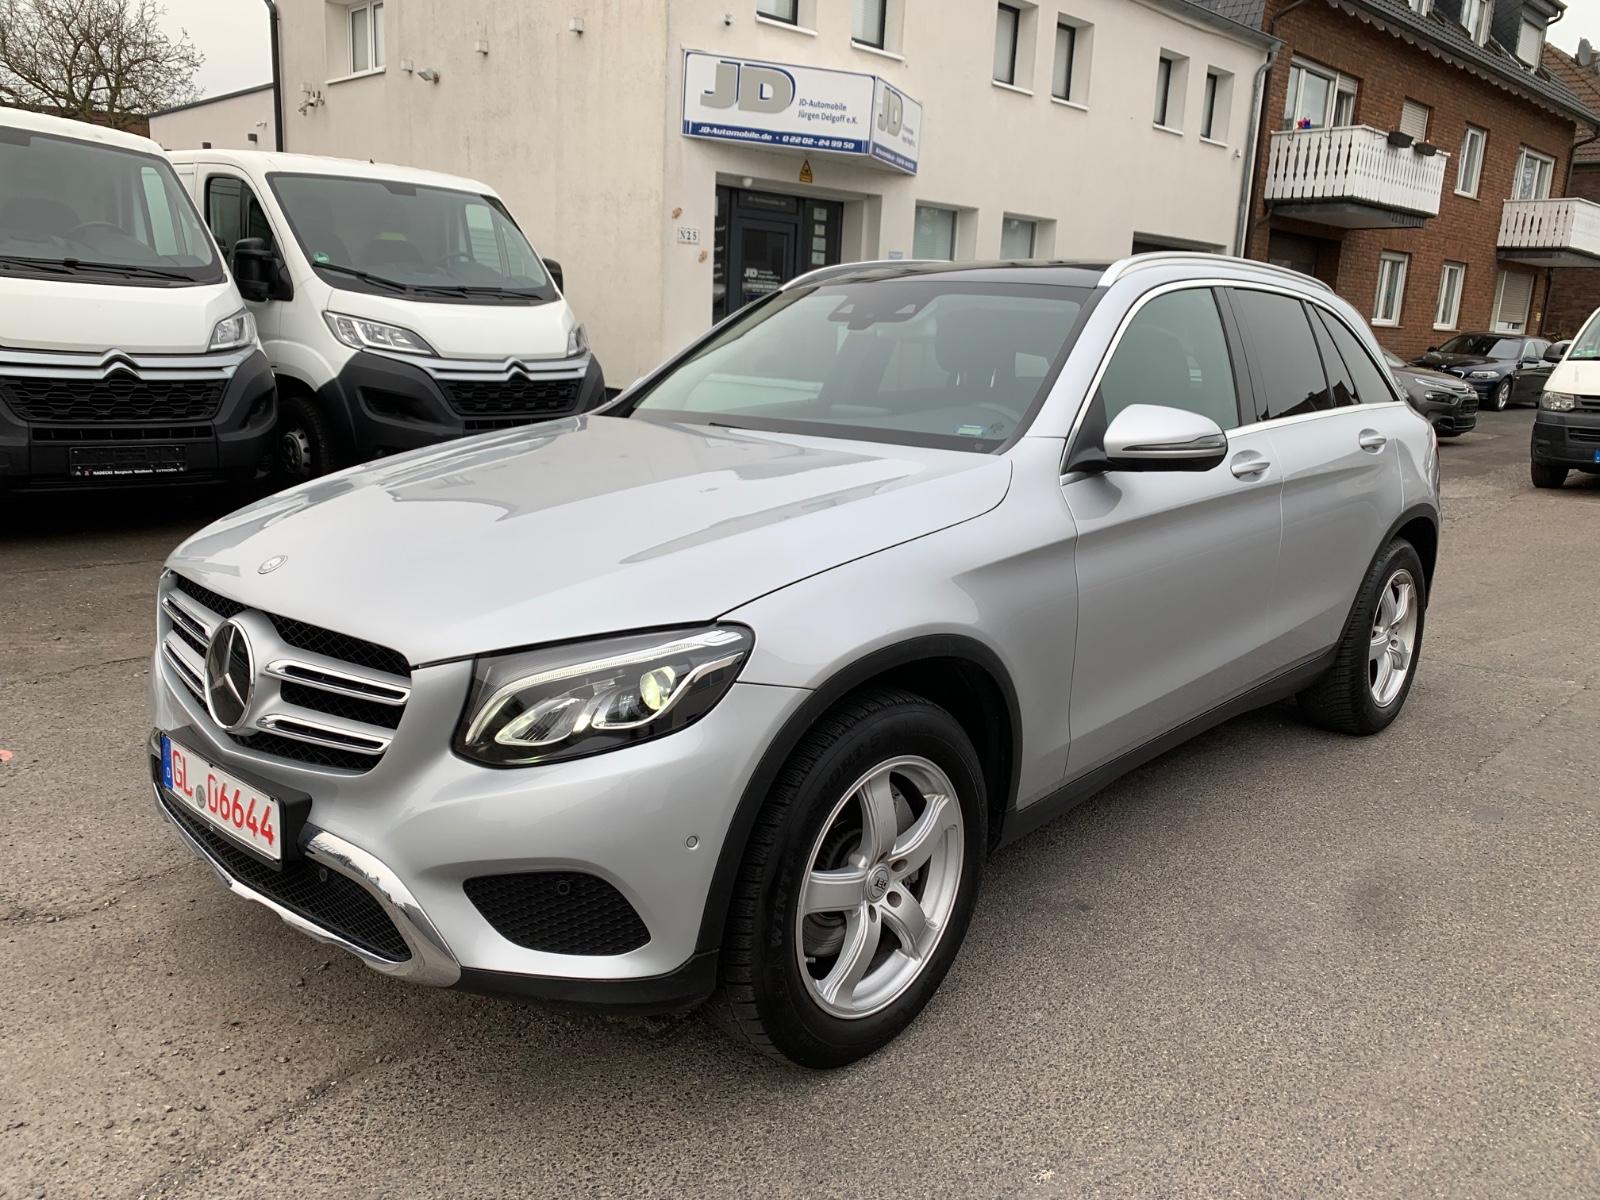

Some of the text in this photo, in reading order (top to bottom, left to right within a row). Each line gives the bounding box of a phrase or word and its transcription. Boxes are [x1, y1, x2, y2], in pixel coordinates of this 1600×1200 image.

[700, 60, 796, 114] JD
[799, 98, 847, 111] JD-Automobile
[798, 110, 858, 124] Jürgen Delgoff e.K.
[877, 86, 903, 137] JD
[698, 126, 772, 141] JD-Automobile.de
[789, 136, 801, 144] 22
[830, 140, 842, 148] 99
[842, 141, 855, 150] 50
[172, 749, 193, 798] GL
